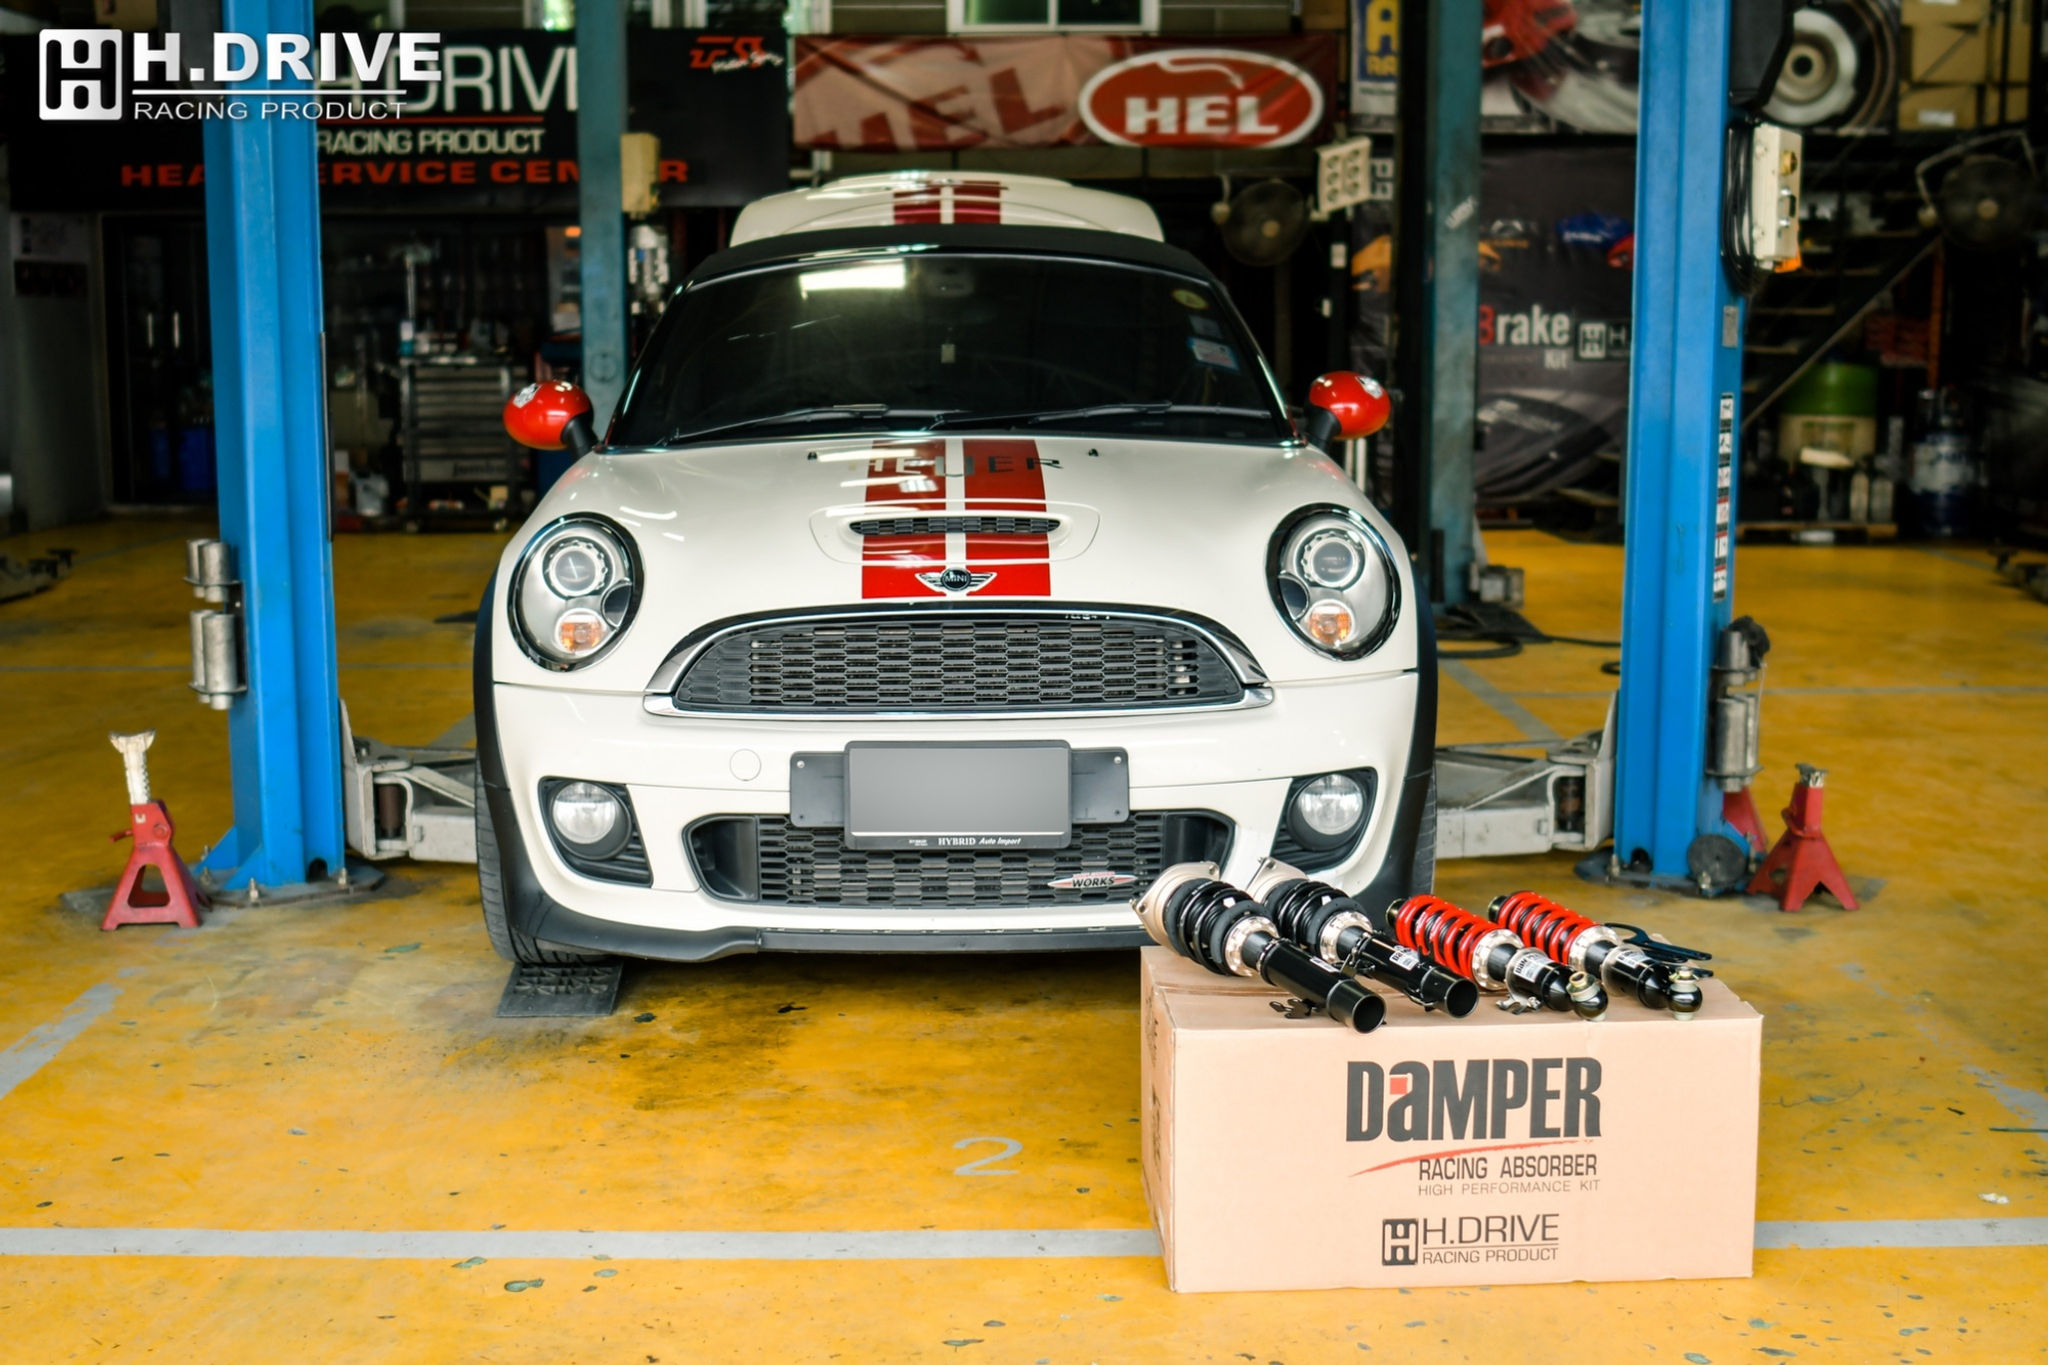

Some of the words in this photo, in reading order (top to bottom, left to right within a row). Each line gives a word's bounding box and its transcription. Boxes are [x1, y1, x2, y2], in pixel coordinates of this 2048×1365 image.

[1125, 97, 1279, 135] HEL
[316, 130, 412, 155] RACING
[418, 128, 545, 155] PRODUCT
[1478, 303, 1570, 345] Brake
[938, 838, 976, 846] HYBRID
[979, 837, 997, 846] Auto
[1072, 876, 1115, 887] WORKS
[953, 1136, 1023, 1176] 2
[1419, 1157, 1488, 1180] RACING
[1500, 1154, 1598, 1178] ABSORBER
[1418, 1183, 1456, 1197] HIGH
[1461, 1180, 1575, 1195] PERFORMANCE
[1580, 1179, 1601, 1192] KIT
[1423, 1213, 1560, 1244] H.DRIVE
[1423, 1250, 1480, 1265] RACING
[1485, 1248, 1560, 1263] PRODUCT
